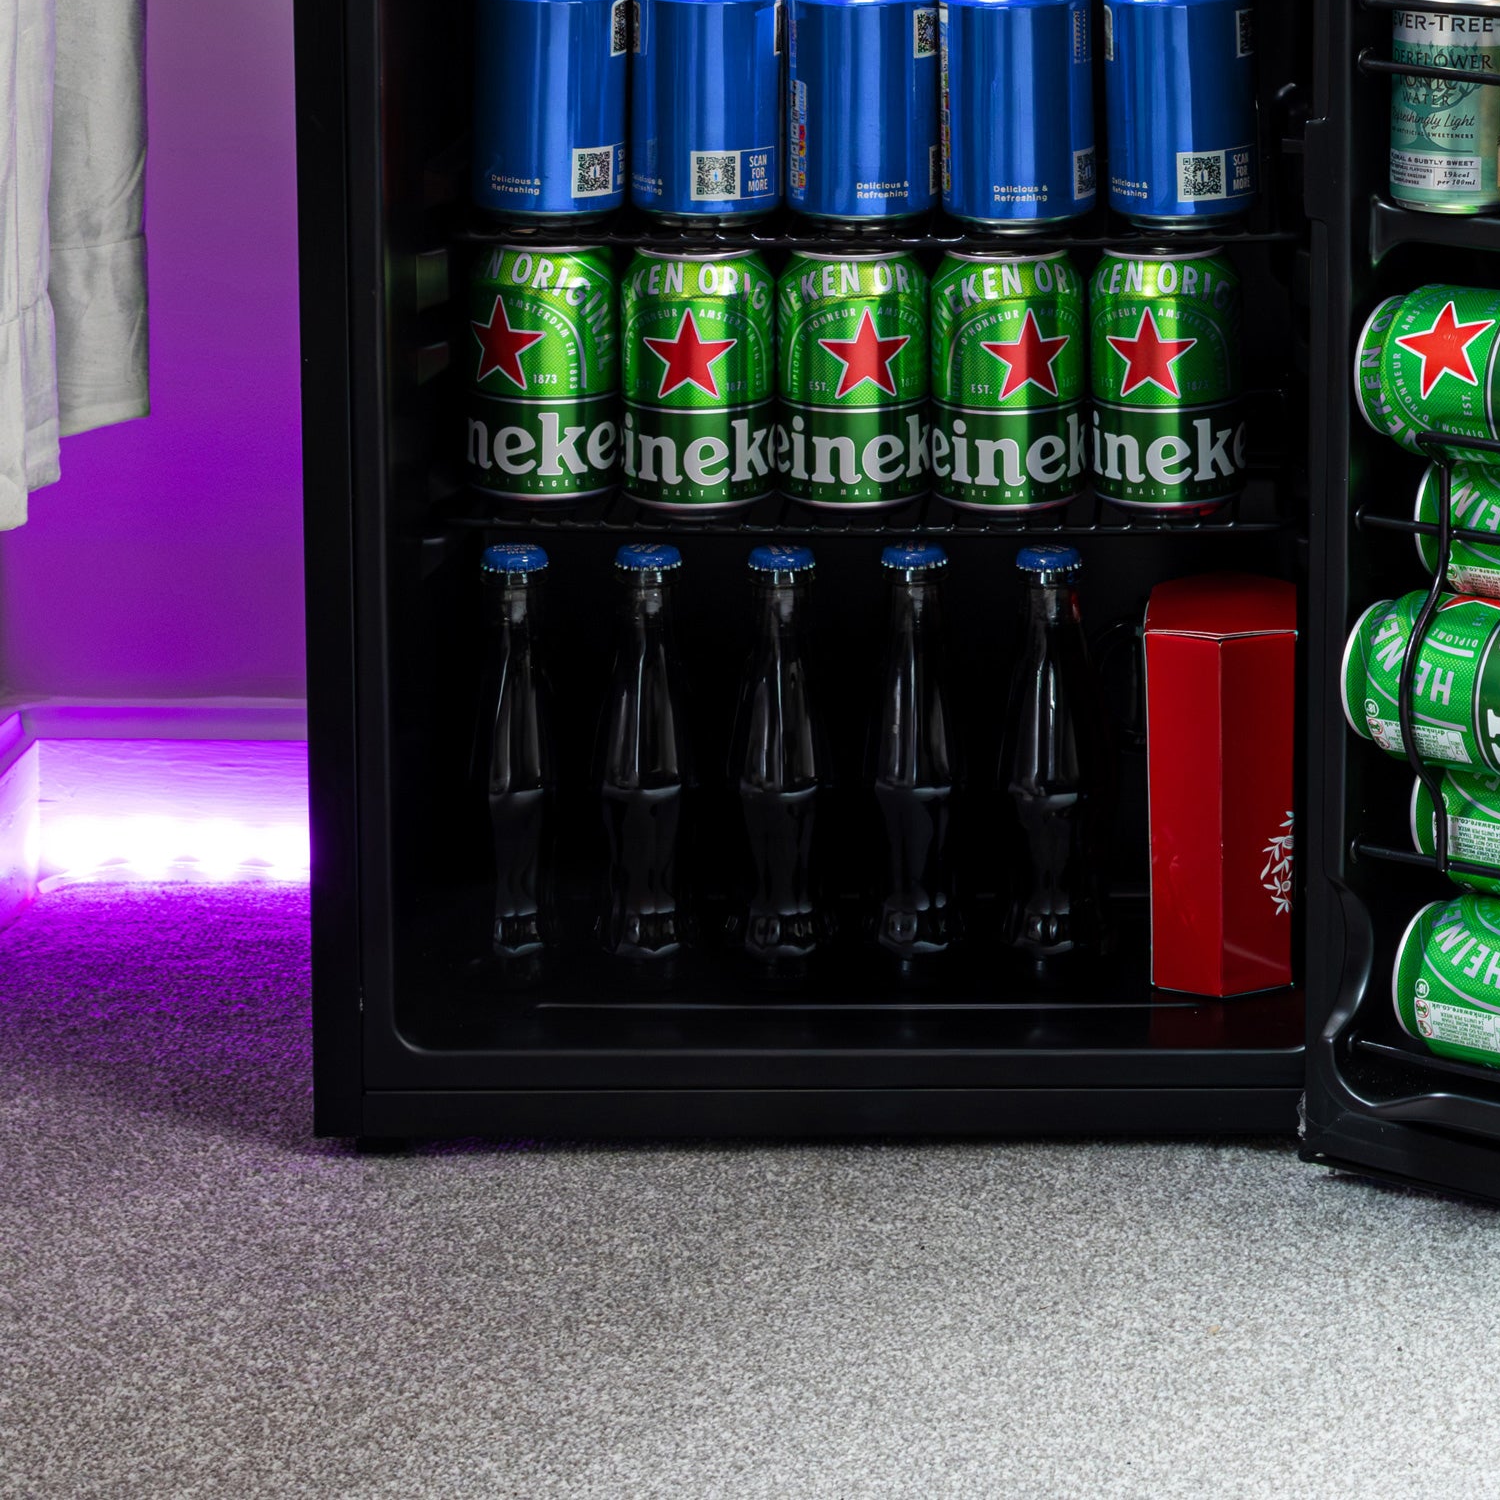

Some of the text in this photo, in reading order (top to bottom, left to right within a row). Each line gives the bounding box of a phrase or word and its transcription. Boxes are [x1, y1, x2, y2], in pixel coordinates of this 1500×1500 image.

[1403, 91, 1451, 107] WATER
[1443, 113, 1475, 130] Light
[748, 154, 767, 167] SCAN
[1233, 152, 1249, 166] SCAN
[1414, 157, 1443, 166] SUBTLY
[751, 167, 765, 179] FOR
[1235, 164, 1247, 177] FOR
[1443, 171, 1470, 179] 19kcal
[491, 173, 541, 186] Delicious &
[747, 179, 768, 192] MORE
[856, 180, 909, 190] Delicious &
[1141, 181, 1148, 189] &
[1233, 177, 1250, 191] MORE
[491, 182, 540, 196] Refreshing
[856, 189, 909, 199] Refreshing
[993, 184, 1048, 193] Delicious &
[993, 193, 1048, 203] Refreshing
[508, 299, 578, 389] AMSTERDAM EN 1883
[533, 374, 558, 384] 1873
[809, 381, 831, 392] EST.
[971, 384, 993, 395] EST.
[1462, 391, 1473, 416] EST.
[1126, 486, 1168, 496] MALT
[1432, 627, 1479, 649] DIPLOME
[1431, 1002, 1493, 1021] drinkaware.co.uk
